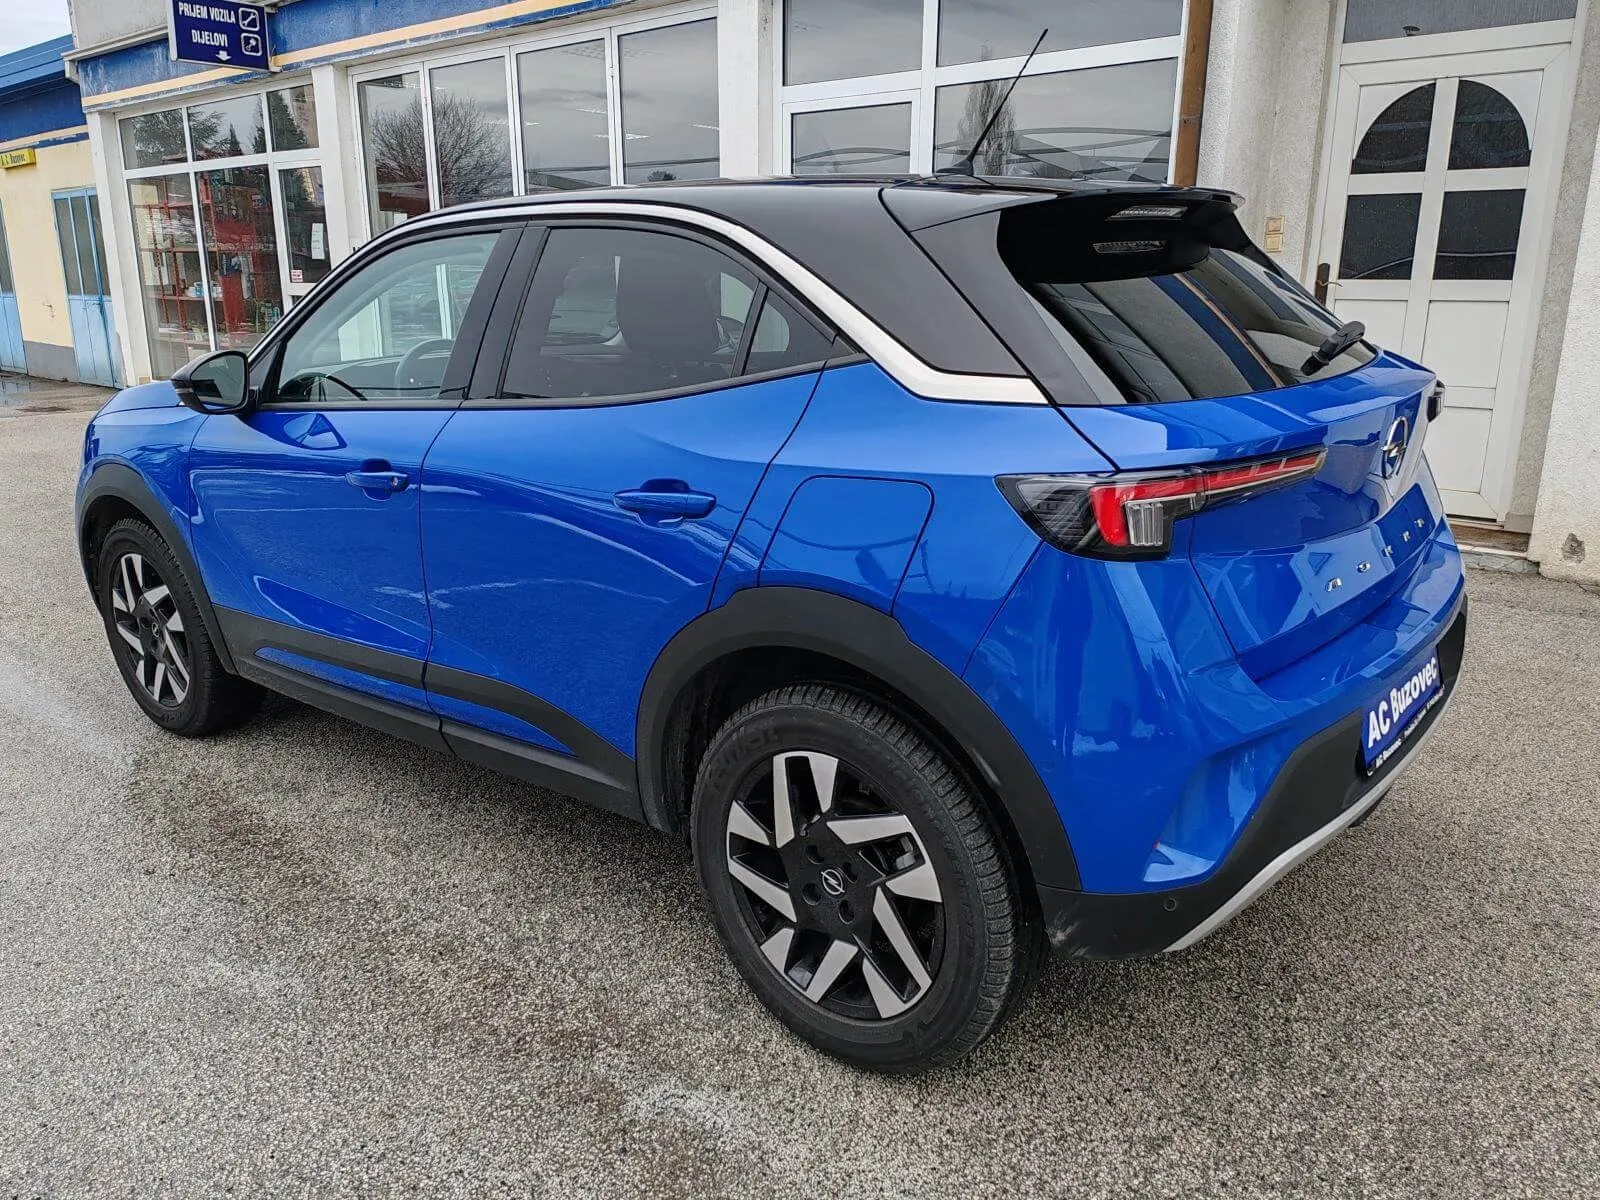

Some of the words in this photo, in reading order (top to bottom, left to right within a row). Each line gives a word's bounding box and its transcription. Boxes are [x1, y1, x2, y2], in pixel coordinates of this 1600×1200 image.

[178, 2, 208, 19] PRIJEM
[209, 7, 236, 24] VOZILA
[191, 29, 228, 47] DIJELOVI
[1368, 700, 1390, 748] AC
[1390, 657, 1437, 724] Buzovec
